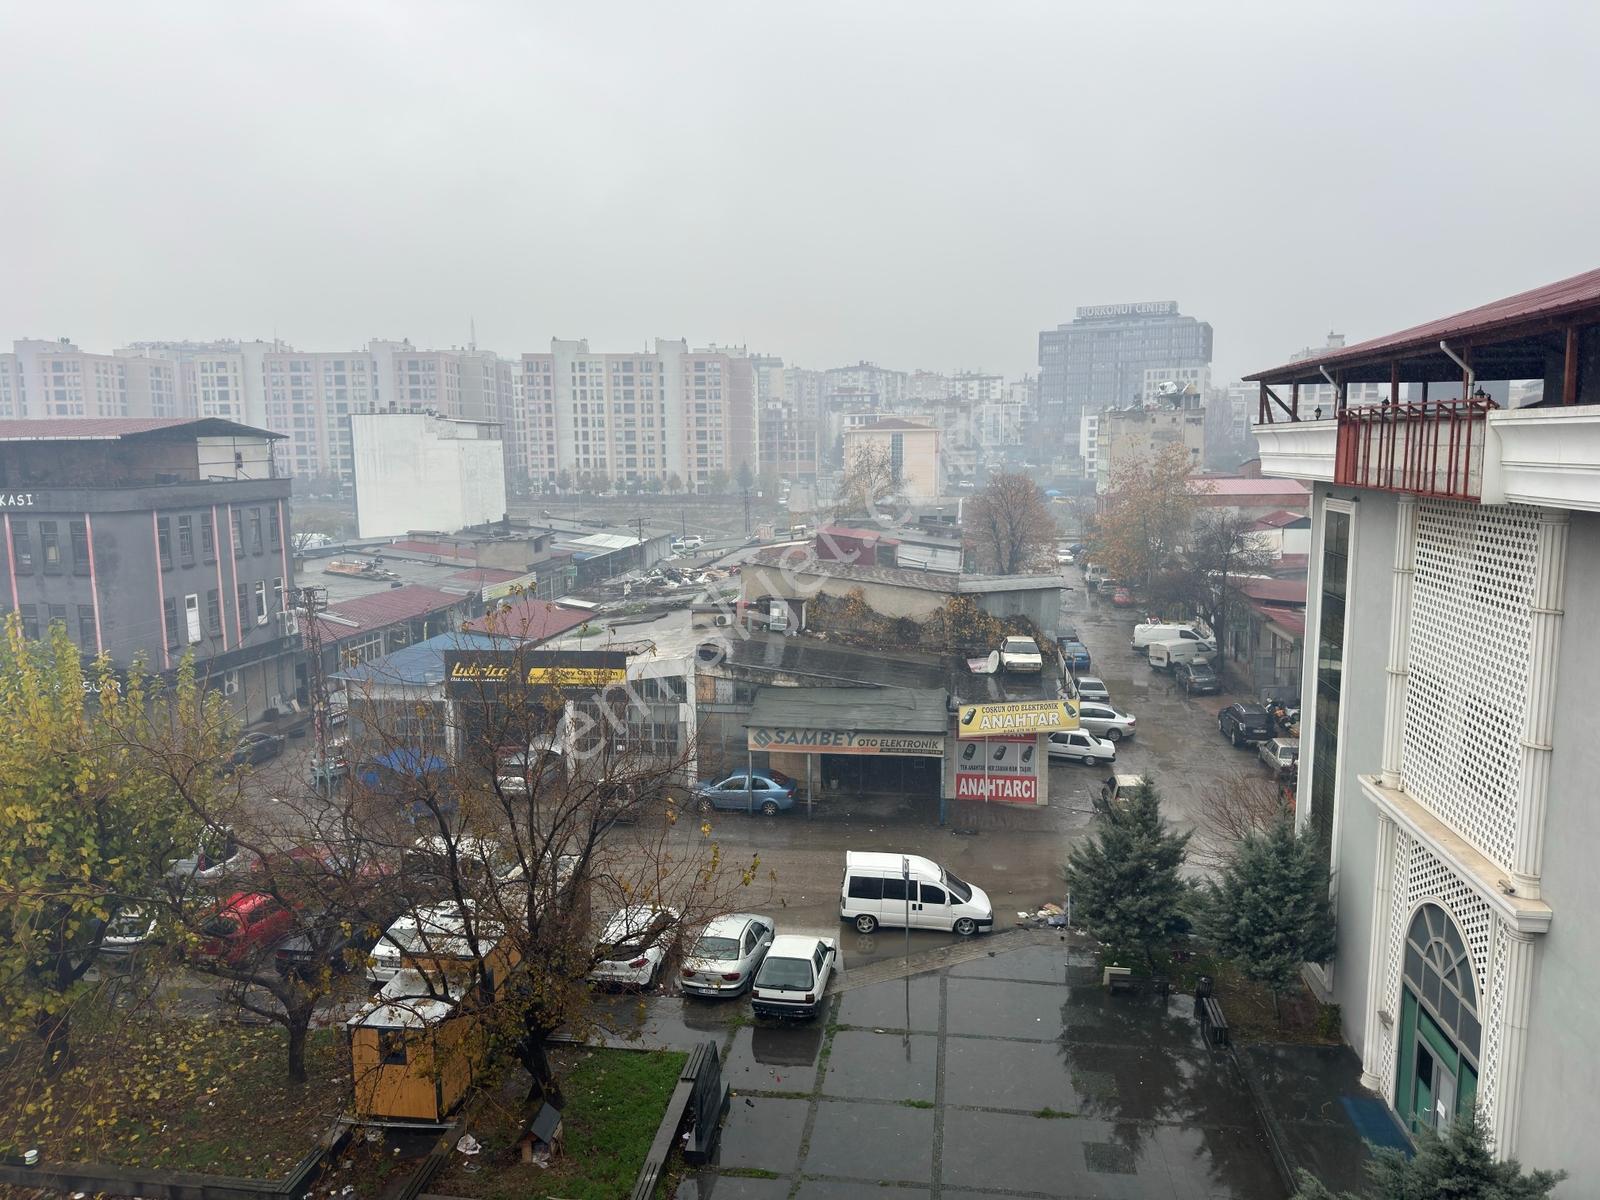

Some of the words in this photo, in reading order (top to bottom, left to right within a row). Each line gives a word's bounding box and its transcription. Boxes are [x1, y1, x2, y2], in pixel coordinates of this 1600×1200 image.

[1135, 302, 1170, 314] CENTER
[1007, 704, 1020, 712] OTO
[980, 712, 1061, 730] ANAHTAR
[774, 727, 858, 747] SAMBEY
[858, 738, 878, 747] OTO
[959, 777, 1036, 799] ANAHTARCI
